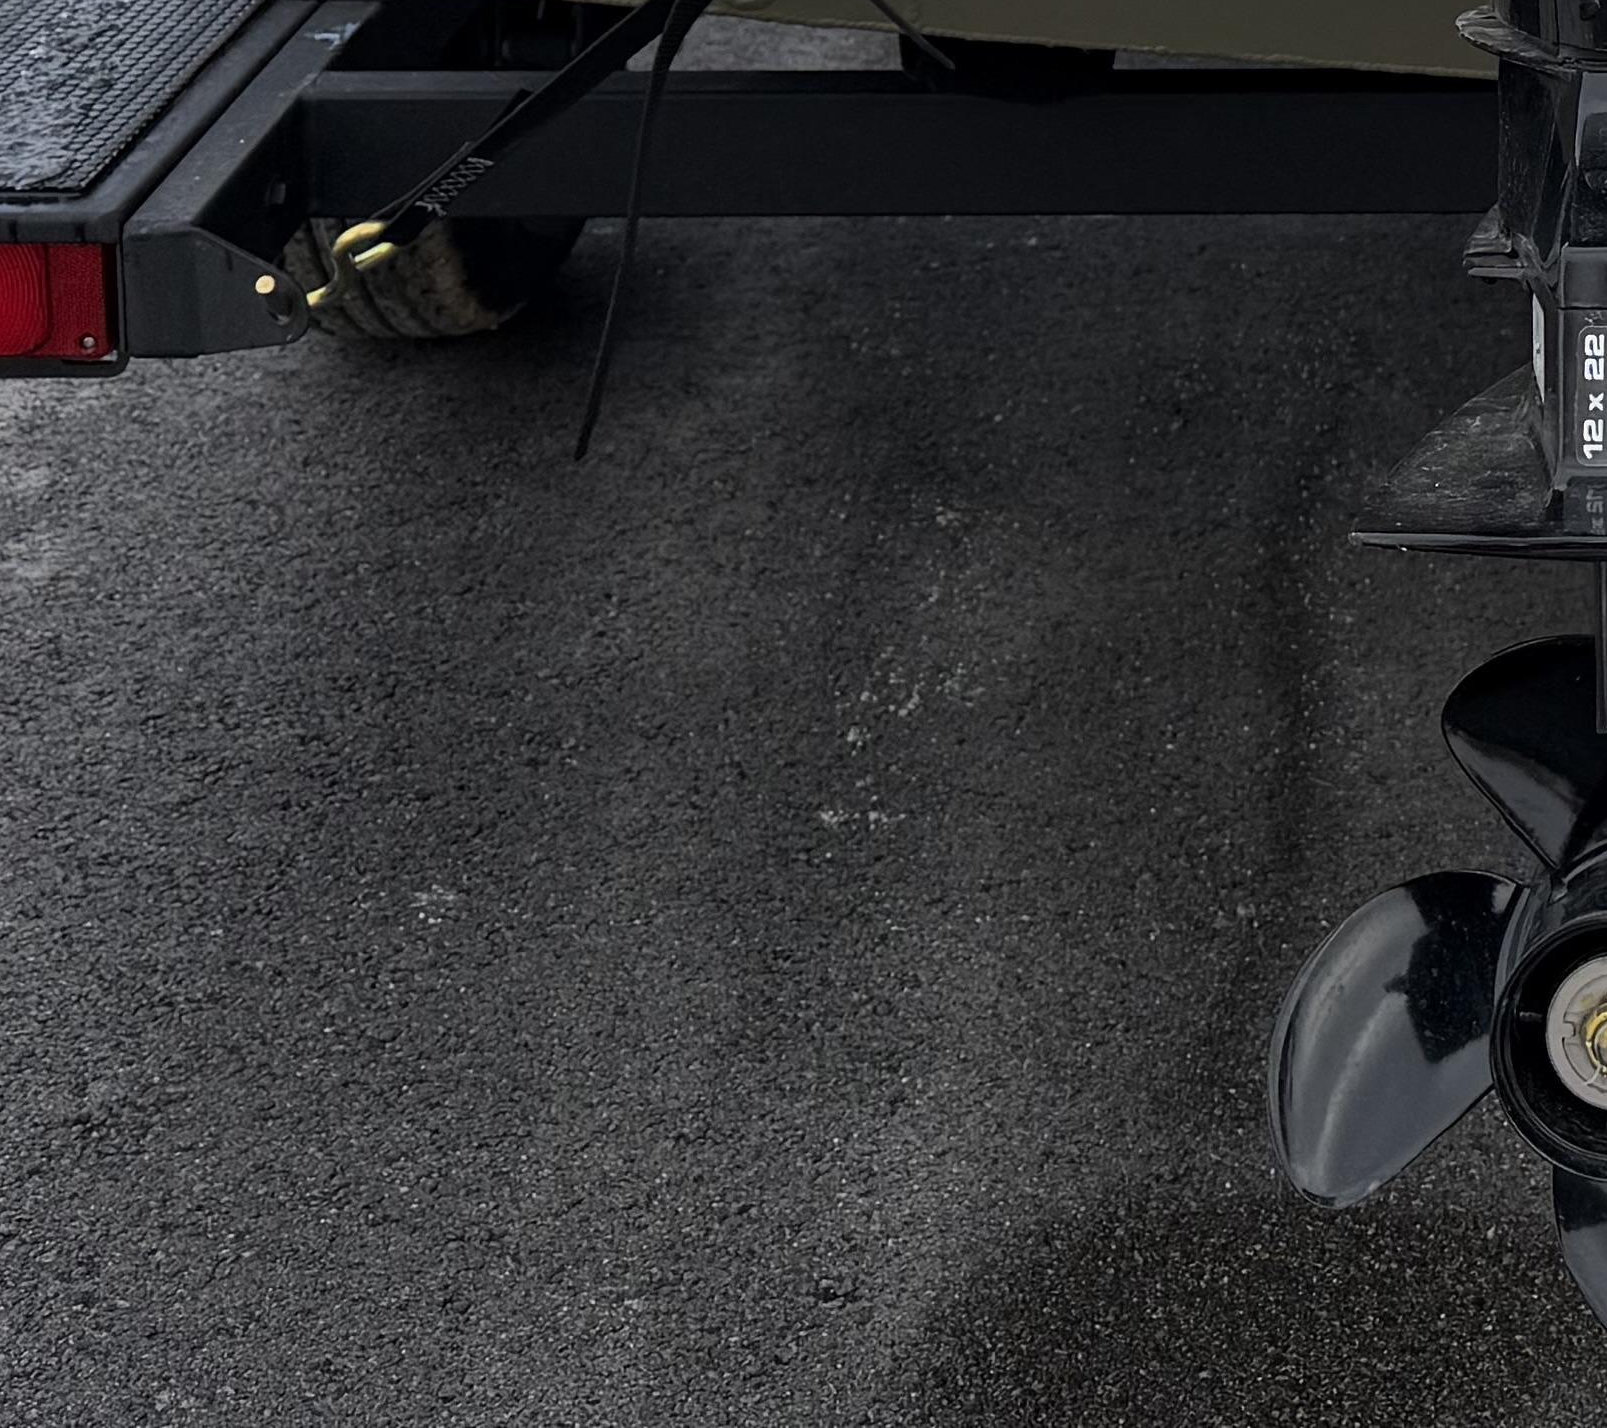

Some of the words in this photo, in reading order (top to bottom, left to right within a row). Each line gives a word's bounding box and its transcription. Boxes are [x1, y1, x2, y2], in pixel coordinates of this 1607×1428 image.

[1584, 334, 1605, 381] 22
[1588, 392, 1604, 412] x
[1583, 419, 1603, 459] 12
